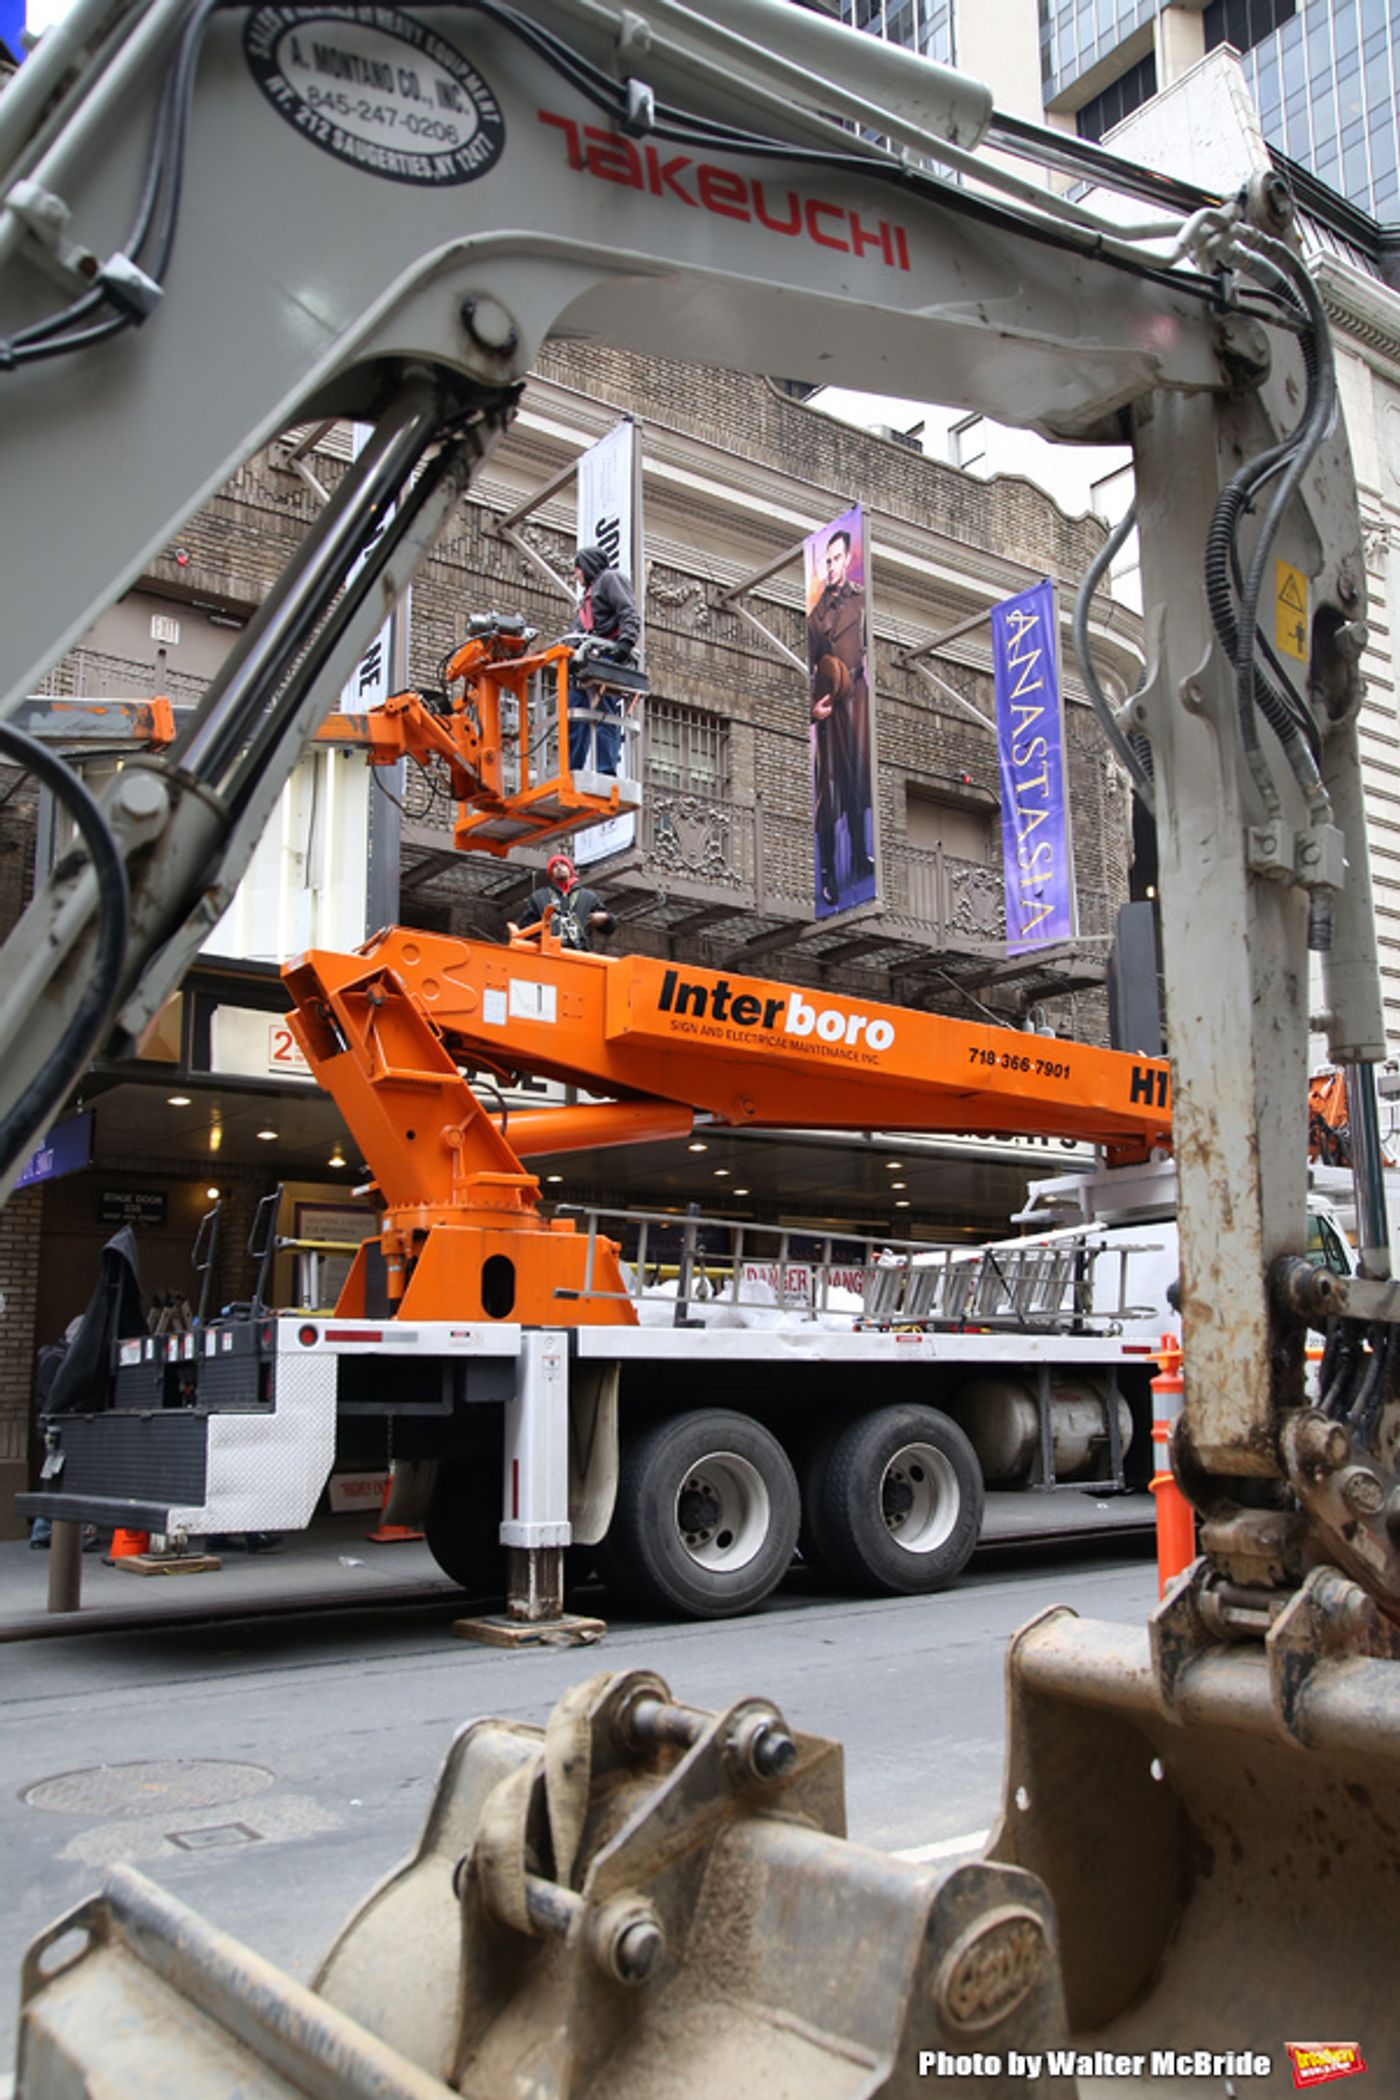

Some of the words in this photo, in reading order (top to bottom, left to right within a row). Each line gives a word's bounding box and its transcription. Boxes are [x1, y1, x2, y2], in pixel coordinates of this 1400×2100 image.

[290, 37, 311, 69] A.
[313, 43, 394, 94] MONTANO
[436, 79, 470, 116] INC.
[294, 107, 332, 141] 212
[456, 132, 495, 172] 12477
[1006, 608, 1056, 936] ANASTASIA
[657, 970, 895, 1051] Interboro
[670, 1019, 699, 1036] SIGN
[700, 1024, 725, 1039] AND
[726, 1028, 787, 1050] ELECTRICAL
[788, 1040, 859, 1062] MAINTENANCE
[135, 1194, 162, 1204] DOOR
